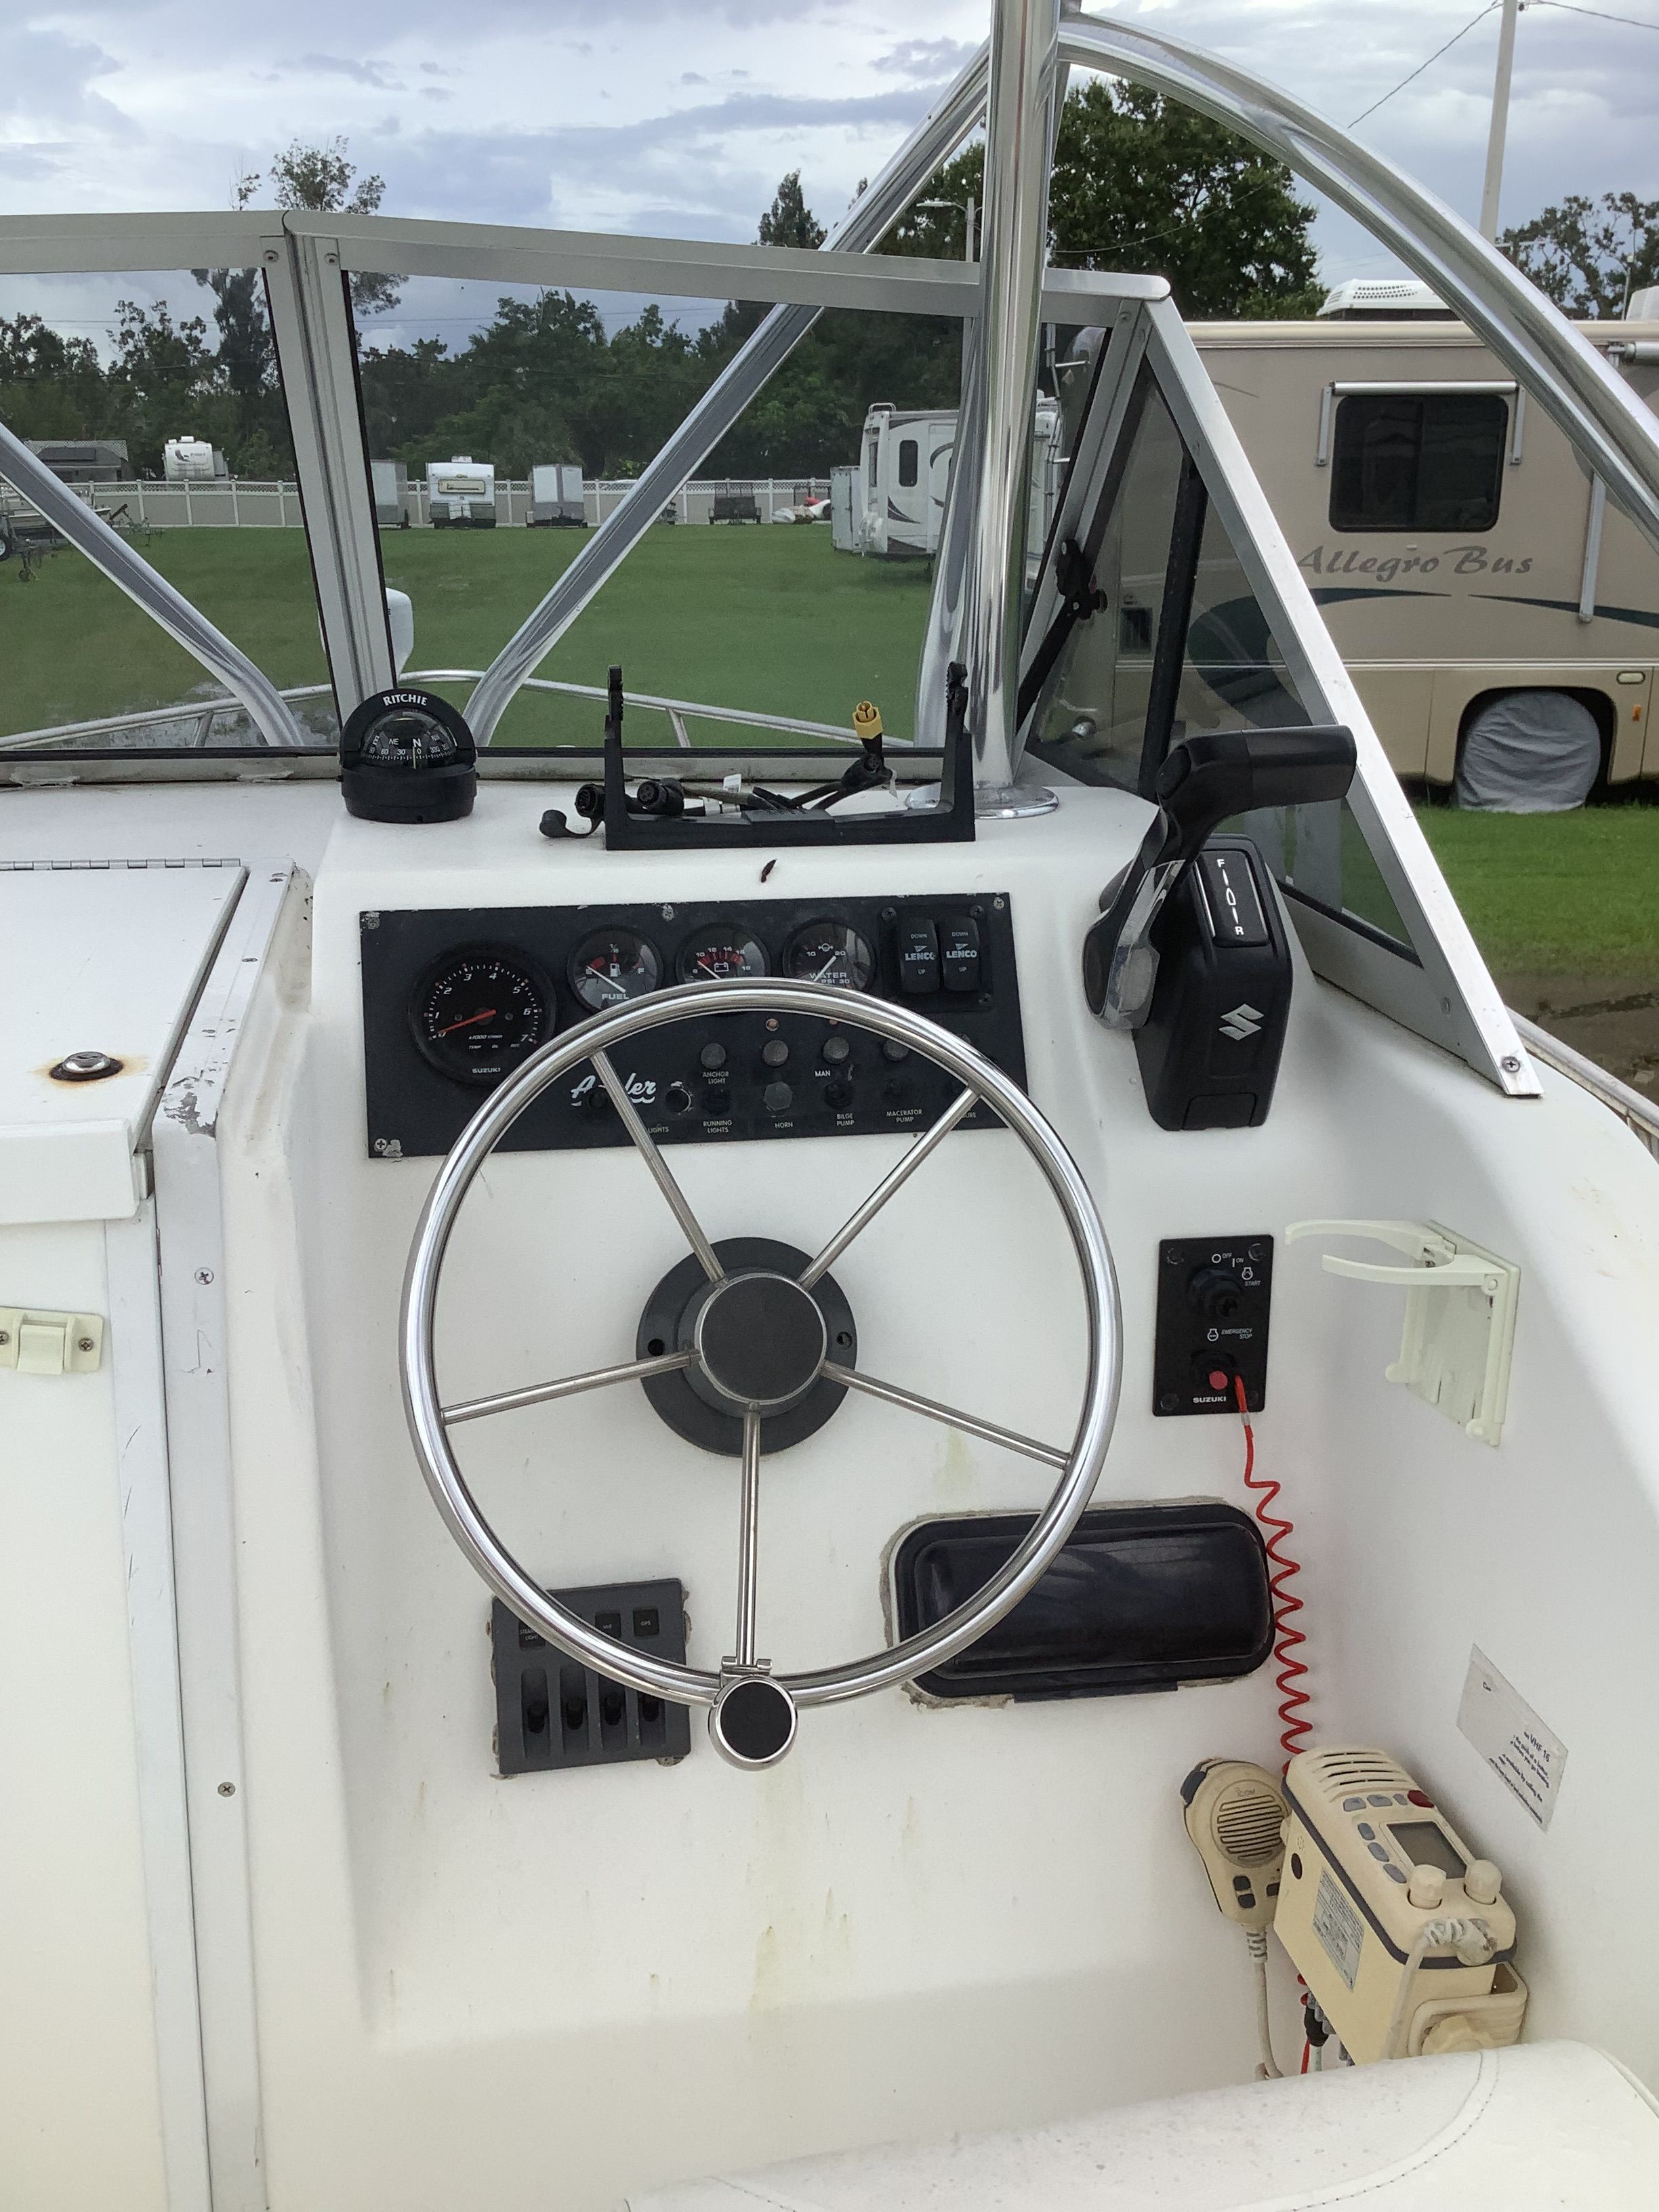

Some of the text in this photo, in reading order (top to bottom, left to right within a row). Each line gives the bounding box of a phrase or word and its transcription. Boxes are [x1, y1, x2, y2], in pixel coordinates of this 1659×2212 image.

[1298, 545, 1534, 583] Allegro Bus
[382, 694, 428, 706] RITCHIE
[413, 738, 422, 747] N
[1217, 859, 1225, 868] F
[1235, 926, 1244, 935] R
[946, 949, 977, 958] LENCO
[571, 1073, 657, 1099] Aler
[886, 1109, 922, 1117] MACERATOR
[1530, 1734, 1543, 1752] VHF
[1543, 1750, 1551, 1763] 16
